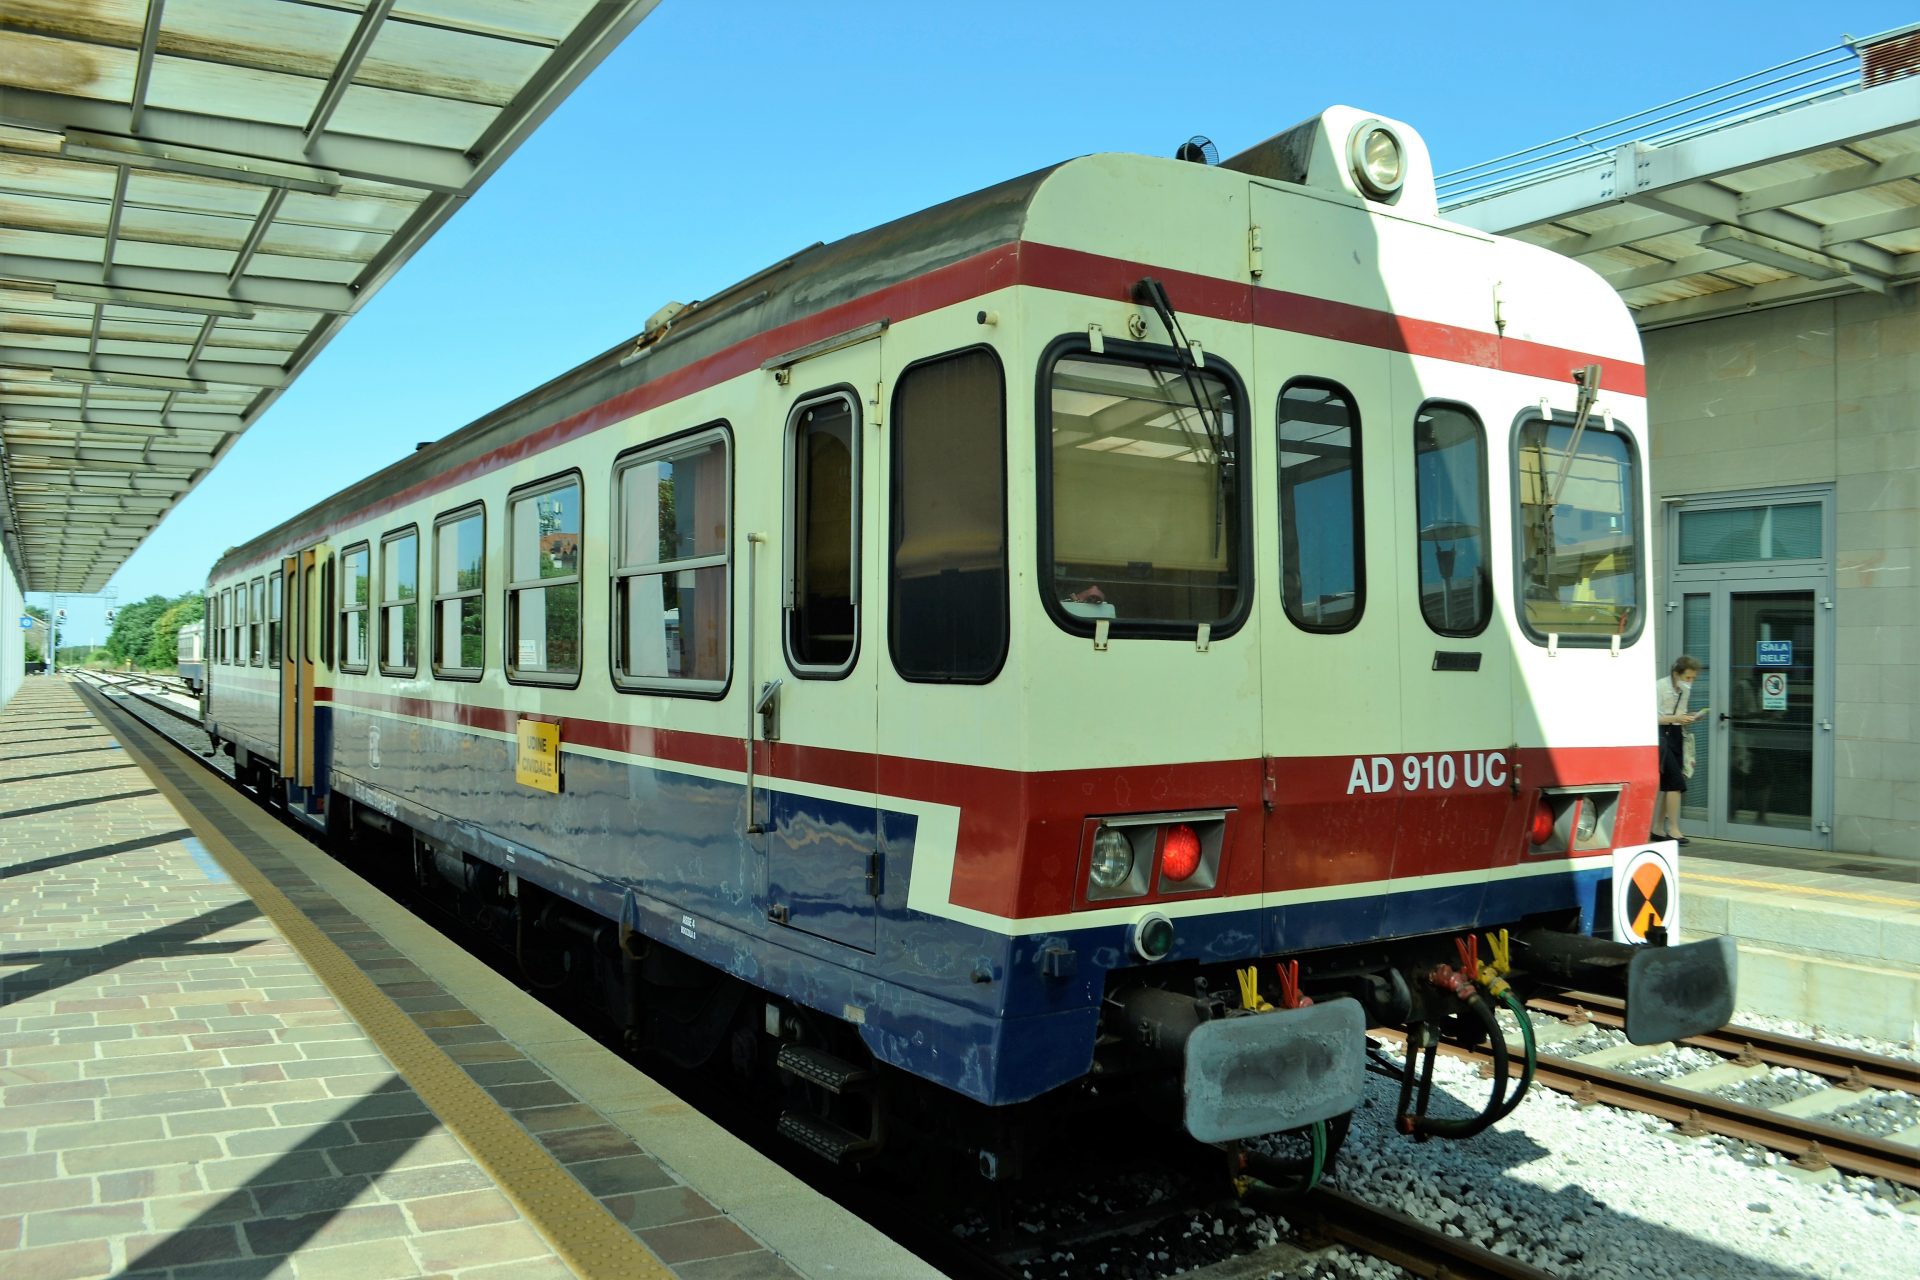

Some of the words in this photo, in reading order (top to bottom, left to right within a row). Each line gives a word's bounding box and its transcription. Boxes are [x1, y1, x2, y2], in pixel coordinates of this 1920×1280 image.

[1761, 644, 1788, 652] SALA
[527, 735, 547, 752] UDINE
[522, 757, 552, 777] CIVIDALE
[1346, 757, 1395, 795] AD
[1402, 754, 1456, 791] 910
[1463, 752, 1507, 788] UC
